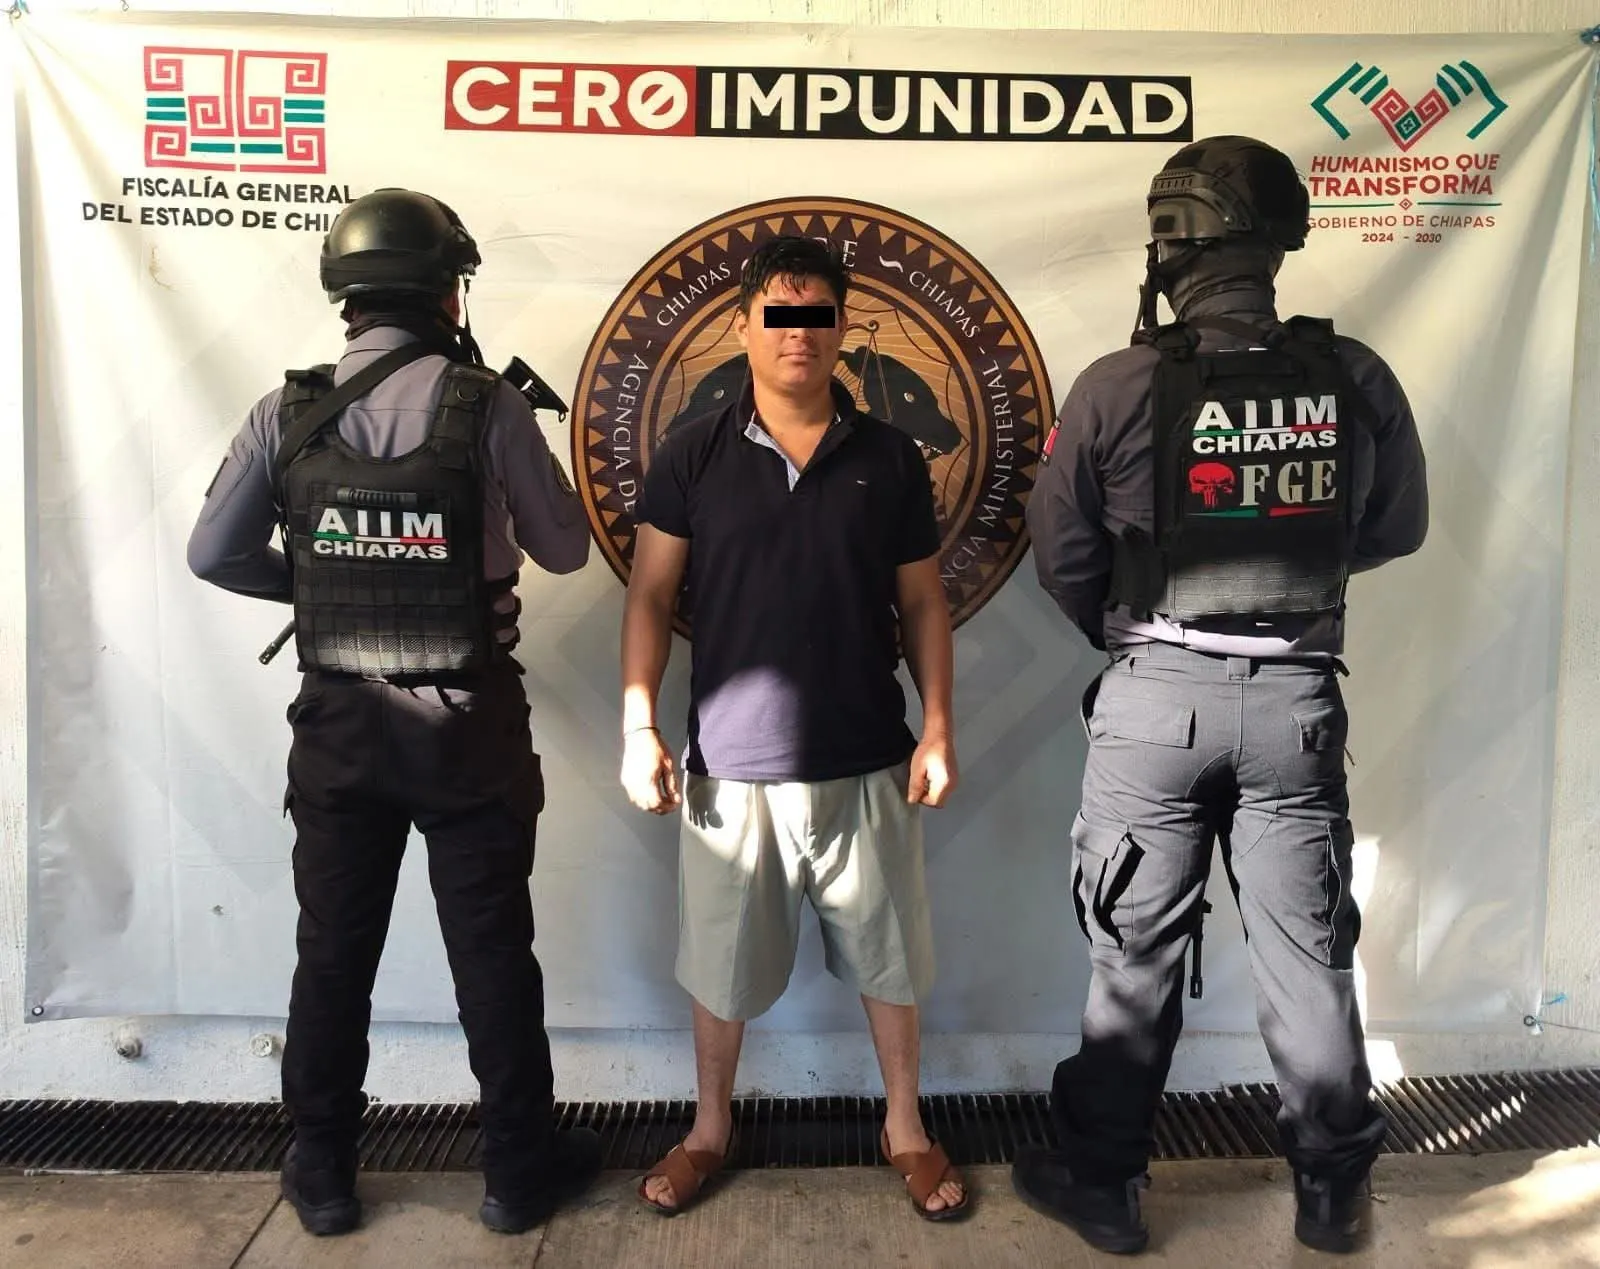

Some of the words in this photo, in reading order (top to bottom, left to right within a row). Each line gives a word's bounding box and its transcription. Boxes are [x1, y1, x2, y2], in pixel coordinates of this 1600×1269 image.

[452, 67, 688, 129] CERO
[710, 71, 1188, 136] IMPUNIDAD
[1311, 155, 1449, 173] HUMANISMO
[1455, 153, 1500, 173] QUE
[121, 176, 230, 200] FISCALÍA
[236, 183, 358, 204] GENERAL
[1309, 174, 1494, 197] TRANSFORMA
[81, 202, 133, 224] DEL
[140, 207, 234, 228] ESTADO
[242, 210, 278, 230] DE
[284, 212, 340, 232] CHI
[1308, 215, 1397, 229] GOBIERNO
[1403, 215, 1425, 227] DE
[1430, 214, 1496, 228] CHIAPAS
[1362, 232, 1394, 243] 2024
[1415, 233, 1442, 243] 2030
[656, 261, 731, 327] CHIAPAS
[909, 270, 981, 338] CHIAPAS
[612, 353, 649, 471] AGENCIA
[1193, 394, 1337, 430] AIIM
[978, 359, 1014, 528] MINISTERIAL
[1192, 429, 1337, 454] CHIAPAS
[1239, 459, 1337, 506] FGE
[315, 507, 443, 538] AIIM
[313, 539, 449, 561] CHIAPAS
